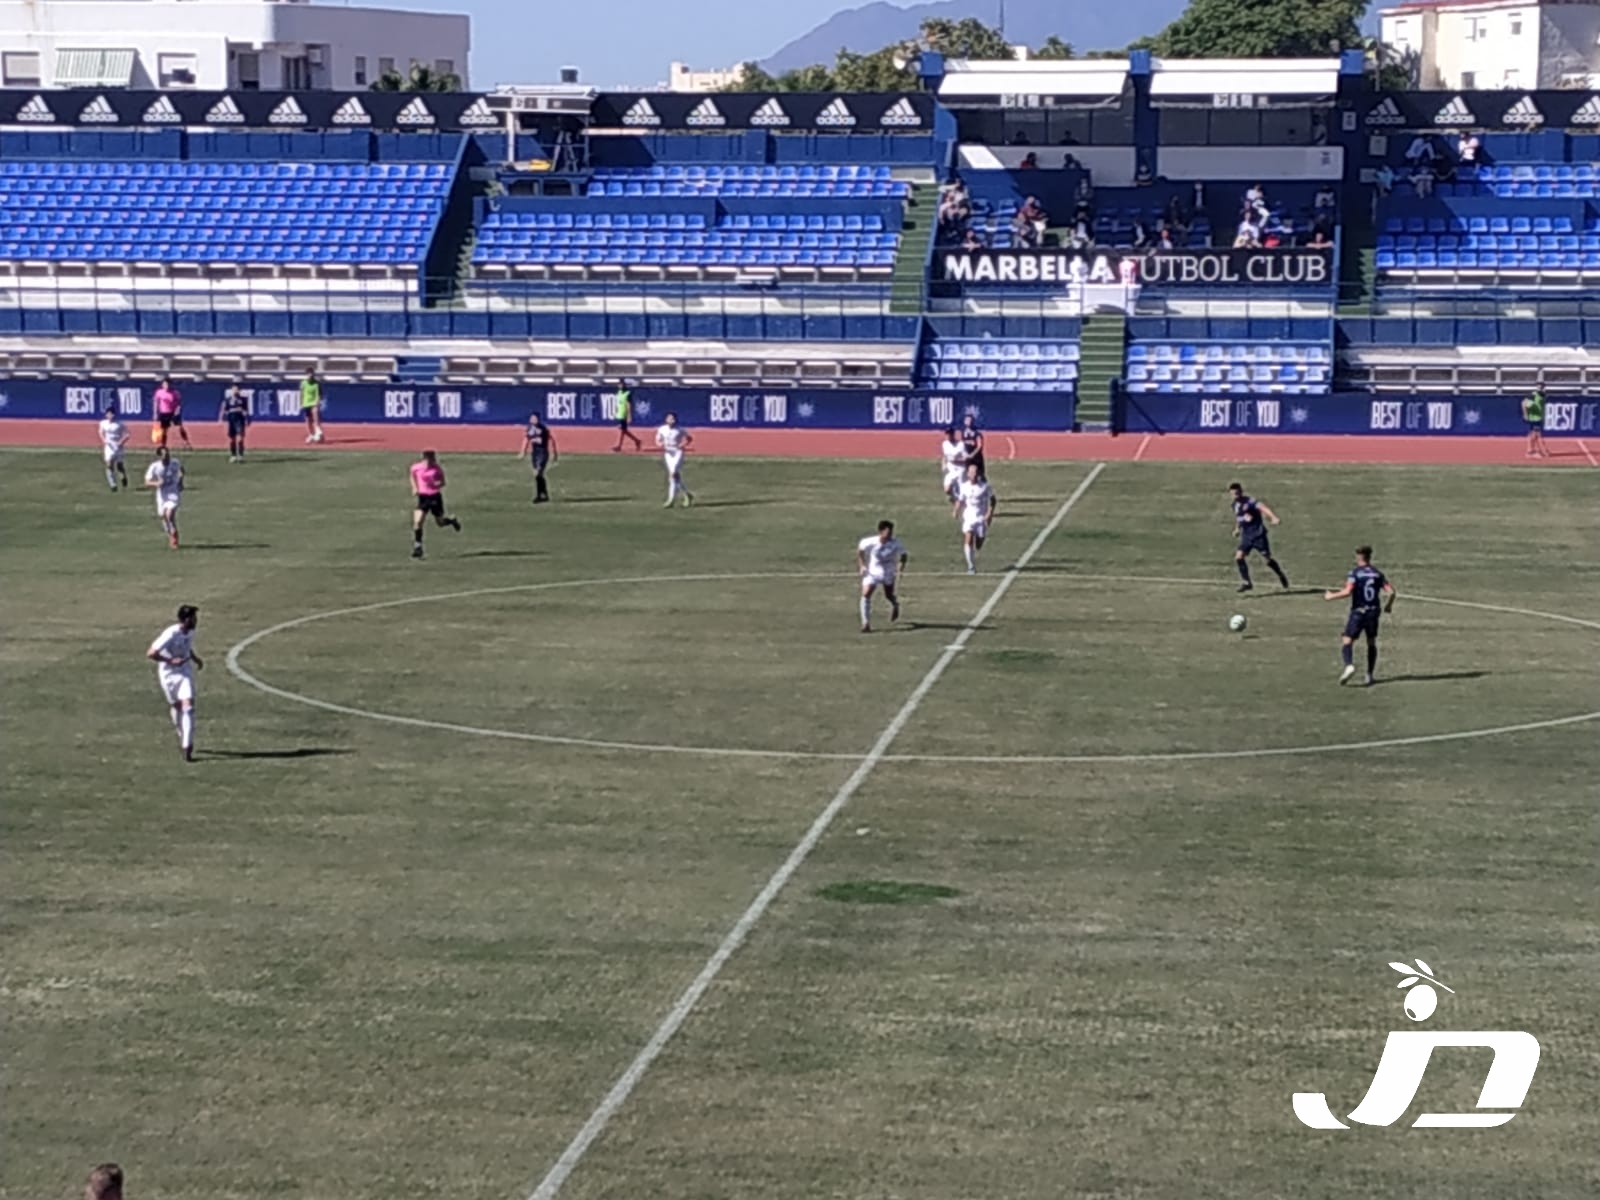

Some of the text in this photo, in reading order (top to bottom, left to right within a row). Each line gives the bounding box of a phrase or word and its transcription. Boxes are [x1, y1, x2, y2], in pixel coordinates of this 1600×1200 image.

[17, 113, 55, 122] adidas
[79, 113, 119, 122] adidas
[143, 113, 181, 122] adidas
[205, 114, 245, 123] adidas
[268, 114, 308, 123] adidas
[332, 114, 371, 124] adidas
[396, 115, 435, 124] adidas
[459, 115, 499, 125] adidas
[622, 115, 661, 125] adidas
[686, 116, 726, 126] adidas
[750, 116, 790, 126] adidas
[815, 116, 856, 126] adidas
[880, 116, 921, 126] adidas
[1365, 115, 1406, 125] adidas
[1434, 114, 1476, 124] adidas
[1502, 114, 1545, 124] adidas
[945, 248, 1326, 281] MARBELA ÚTBOL CLUB
[65, 387, 141, 414] BEST OF YOU
[258, 389, 273, 416] OF
[276, 389, 301, 416] YOU
[385, 391, 461, 418] BEST OF YOU
[547, 392, 577, 419] BEST
[581, 393, 595, 419] OF
[710, 395, 787, 422] BEST OF YOU
[873, 396, 953, 424] BEST OF YOU
[1201, 400, 1280, 428] BEST OF YOU
[1371, 402, 1452, 430] BEST OF YOU
[1545, 403, 1598, 430] BEST OF
[1364, 579, 1375, 602] 6
